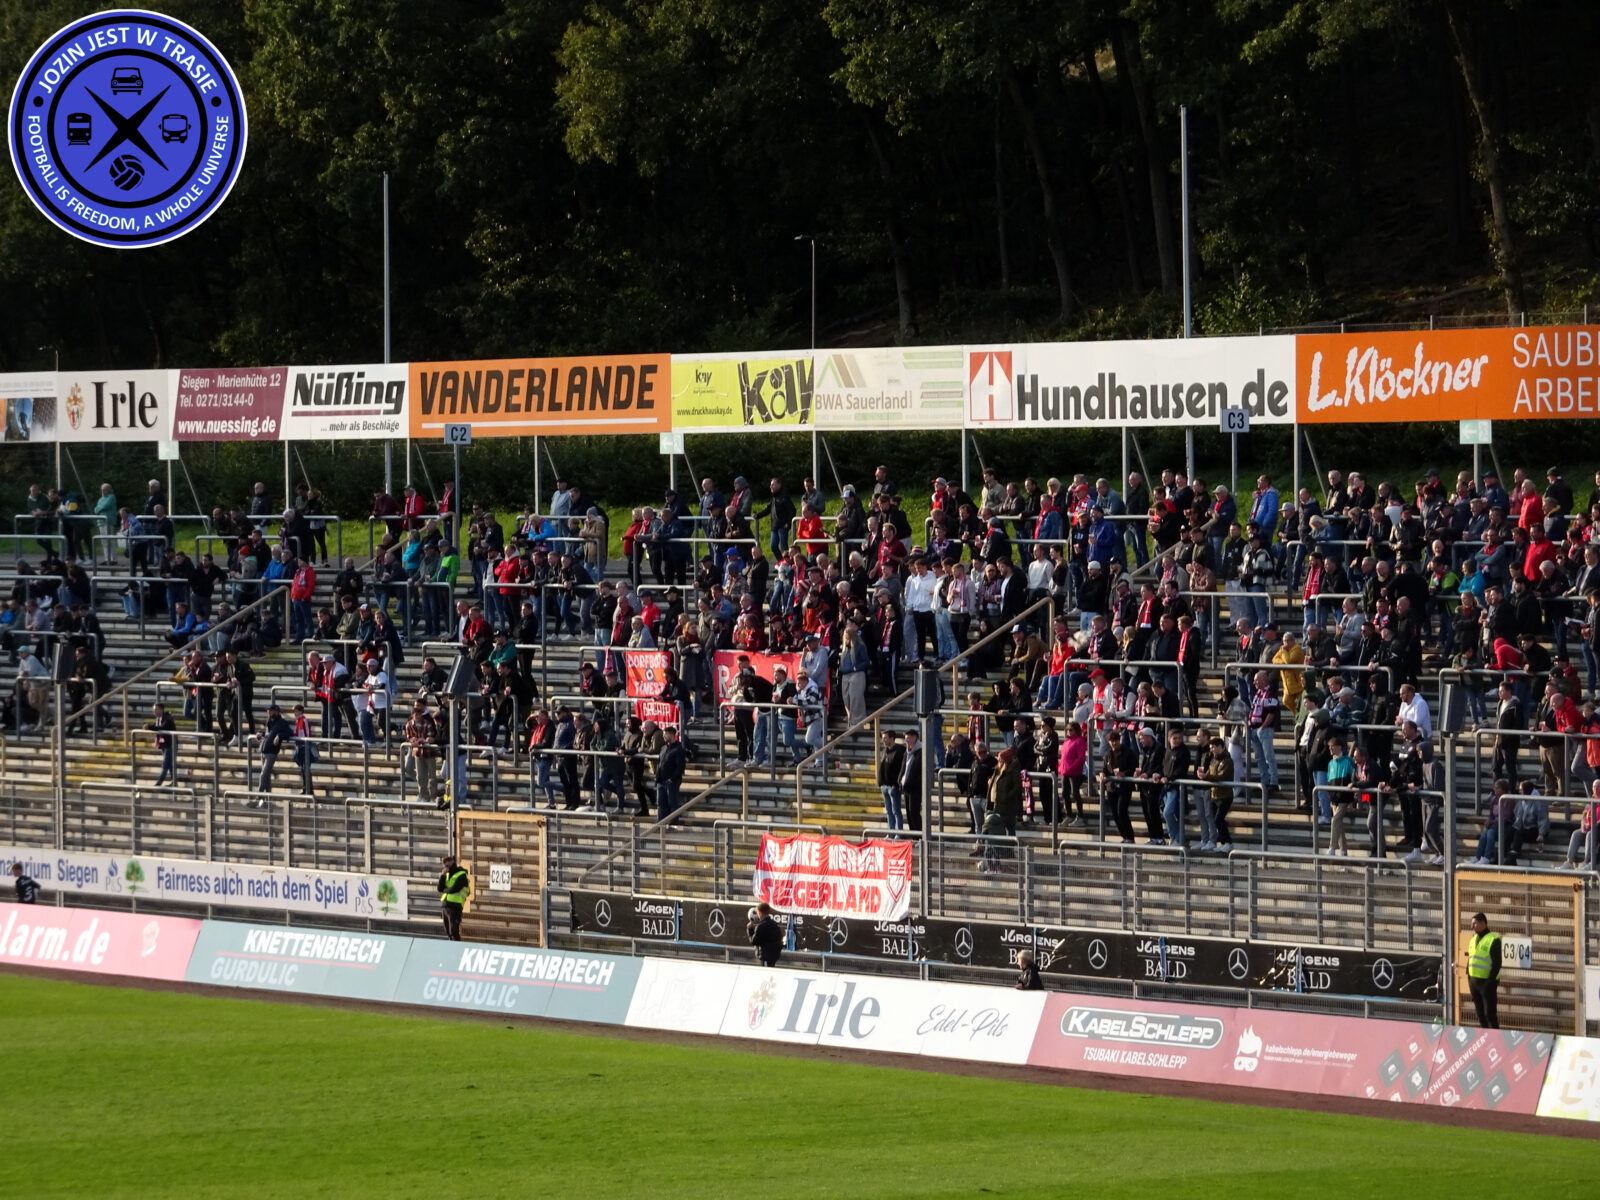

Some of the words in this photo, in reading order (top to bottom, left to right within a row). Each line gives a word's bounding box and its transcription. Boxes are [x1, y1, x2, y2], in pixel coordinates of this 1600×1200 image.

[1513, 331, 1600, 368] SAUB
[182, 375, 210, 391] Siegen
[217, 373, 268, 388] Marienhütte
[270, 373, 281, 387] 12
[420, 364, 658, 415] VANDERLANDE
[1308, 341, 1488, 412] L.Klöckner
[91, 380, 158, 428] Irle
[180, 394, 194, 407] Tel.
[196, 393, 254, 408] 0271/3144-0
[293, 371, 406, 415] Nüßing
[815, 393, 843, 410] BWA
[846, 389, 908, 410] Sauerland
[1017, 368, 1289, 421] Hundhausende
[1513, 377, 1600, 413] ARBE
[677, 406, 732, 416] www.druckhauskay.de
[1228, 412, 1245, 429] C3
[178, 416, 277, 437] www.nuessing.de
[329, 421, 347, 431] mehr
[349, 421, 360, 431] als
[362, 420, 399, 432] Beschläge
[451, 426, 467, 442] C2
[57, 858, 98, 888] Siegen
[157, 866, 211, 894] Fairness
[214, 872, 243, 896] auch
[248, 874, 278, 898] nach
[282, 875, 311, 901] dem
[315, 877, 348, 909] Spiel
[355, 896, 374, 913] P&S
[0, 910, 110, 965] larm.de
[642, 918, 676, 936] BALD
[243, 929, 386, 964] KNETTENBRECH
[1009, 948, 1051, 970] BD
[1503, 943, 1530, 960] C3/C4
[211, 957, 299, 986] GURDULIC
[458, 947, 616, 986] KNETTENBRECH
[1144, 959, 1187, 978] BALD
[423, 977, 520, 1008] GURDULIC
[777, 977, 881, 1039] Irle
[1083, 1047, 1120, 1063] TSUBAKI
[1120, 1051, 1187, 1069] KABELSCHLEPP
